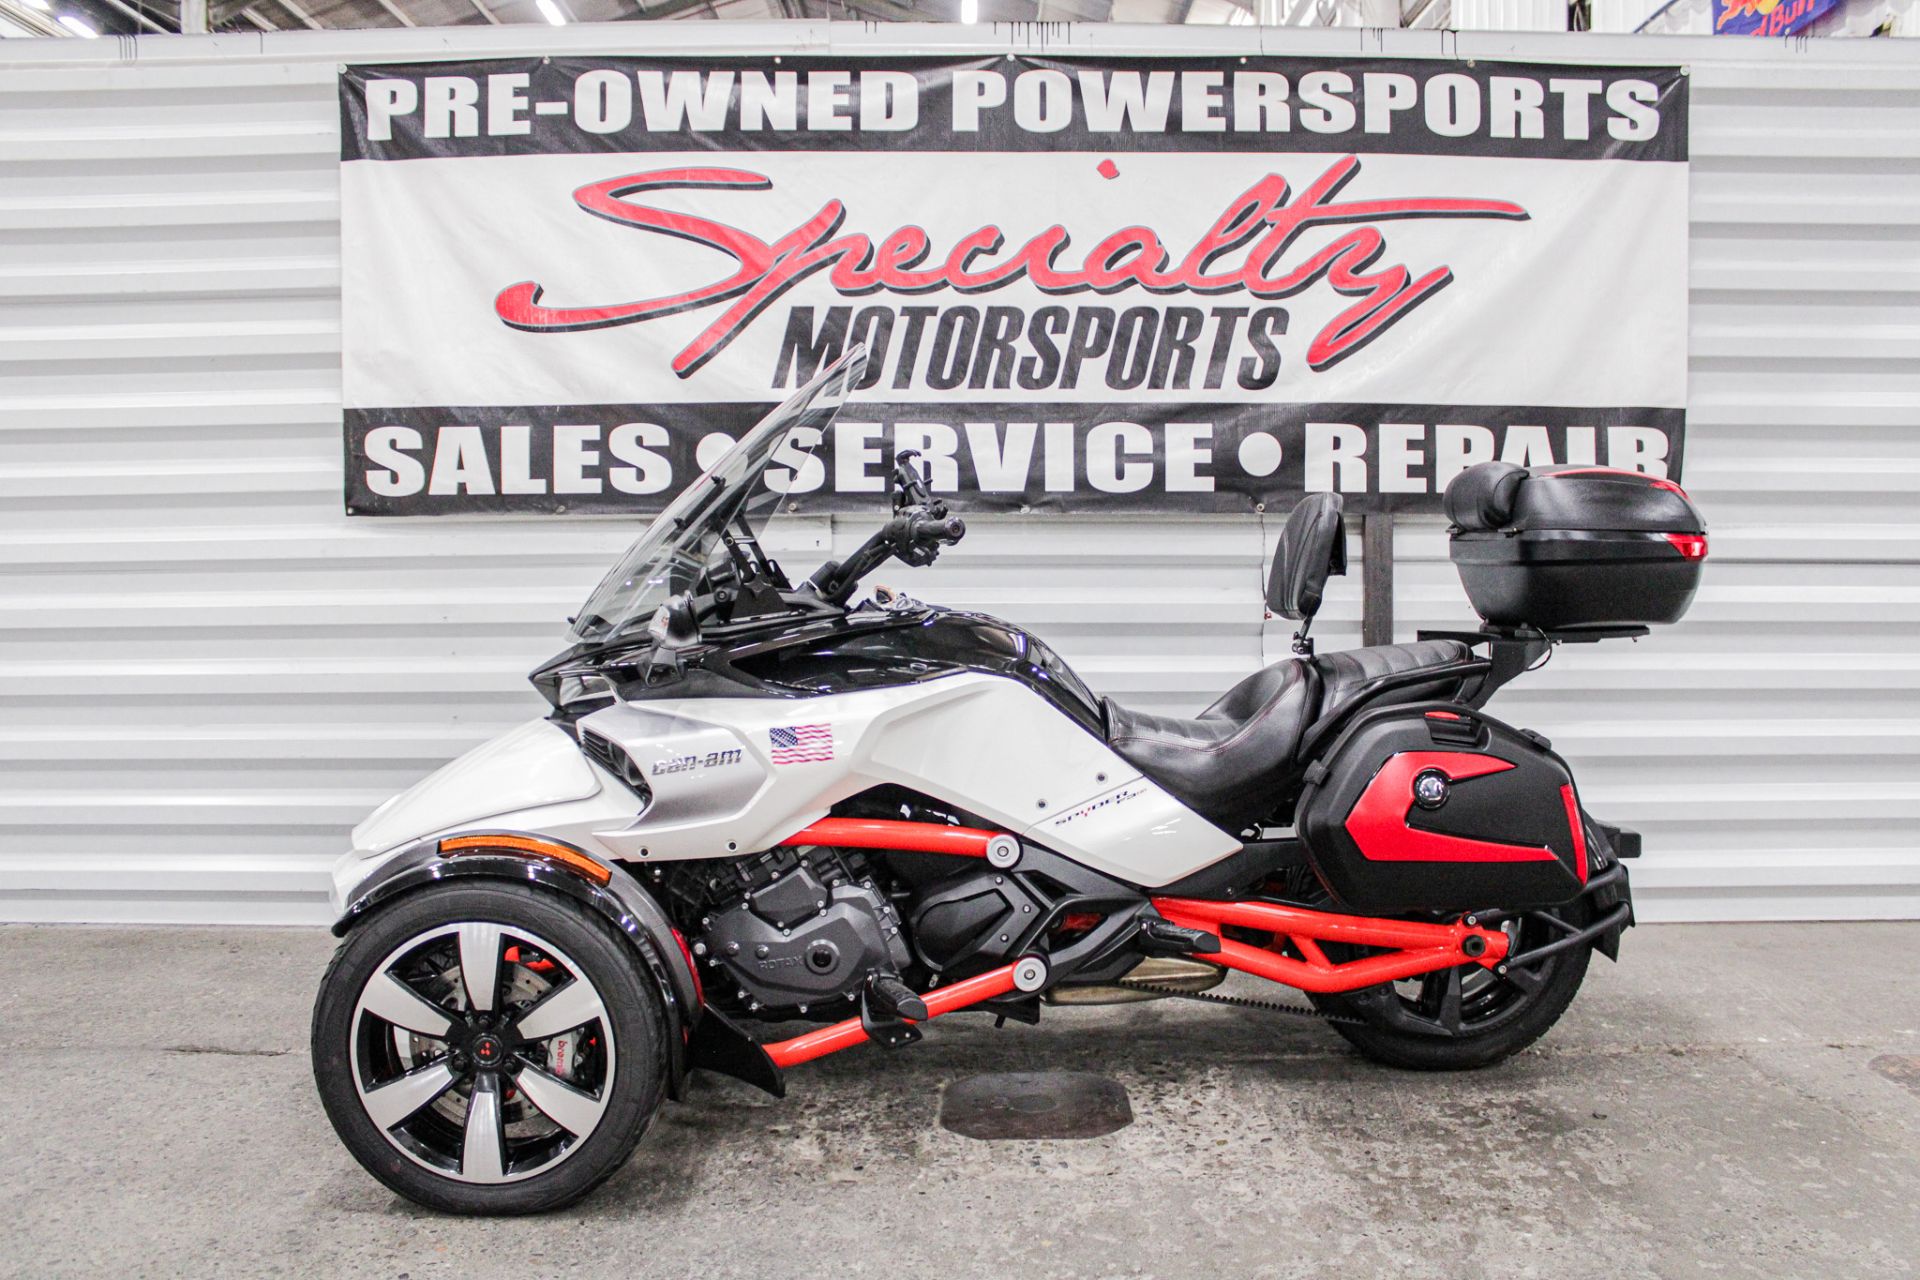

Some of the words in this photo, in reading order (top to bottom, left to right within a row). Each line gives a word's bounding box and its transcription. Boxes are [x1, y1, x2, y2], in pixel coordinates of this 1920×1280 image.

[364, 69, 919, 142] PRE-OWNED
[951, 69, 1661, 143] POWERSPORTS
[493, 153, 1532, 379] Specialty
[770, 304, 1289, 391] MOTORSPORTS
[364, 422, 674, 498] SALES
[763, 421, 1216, 494] SERVICE
[1304, 422, 1670, 493] REPAIR
